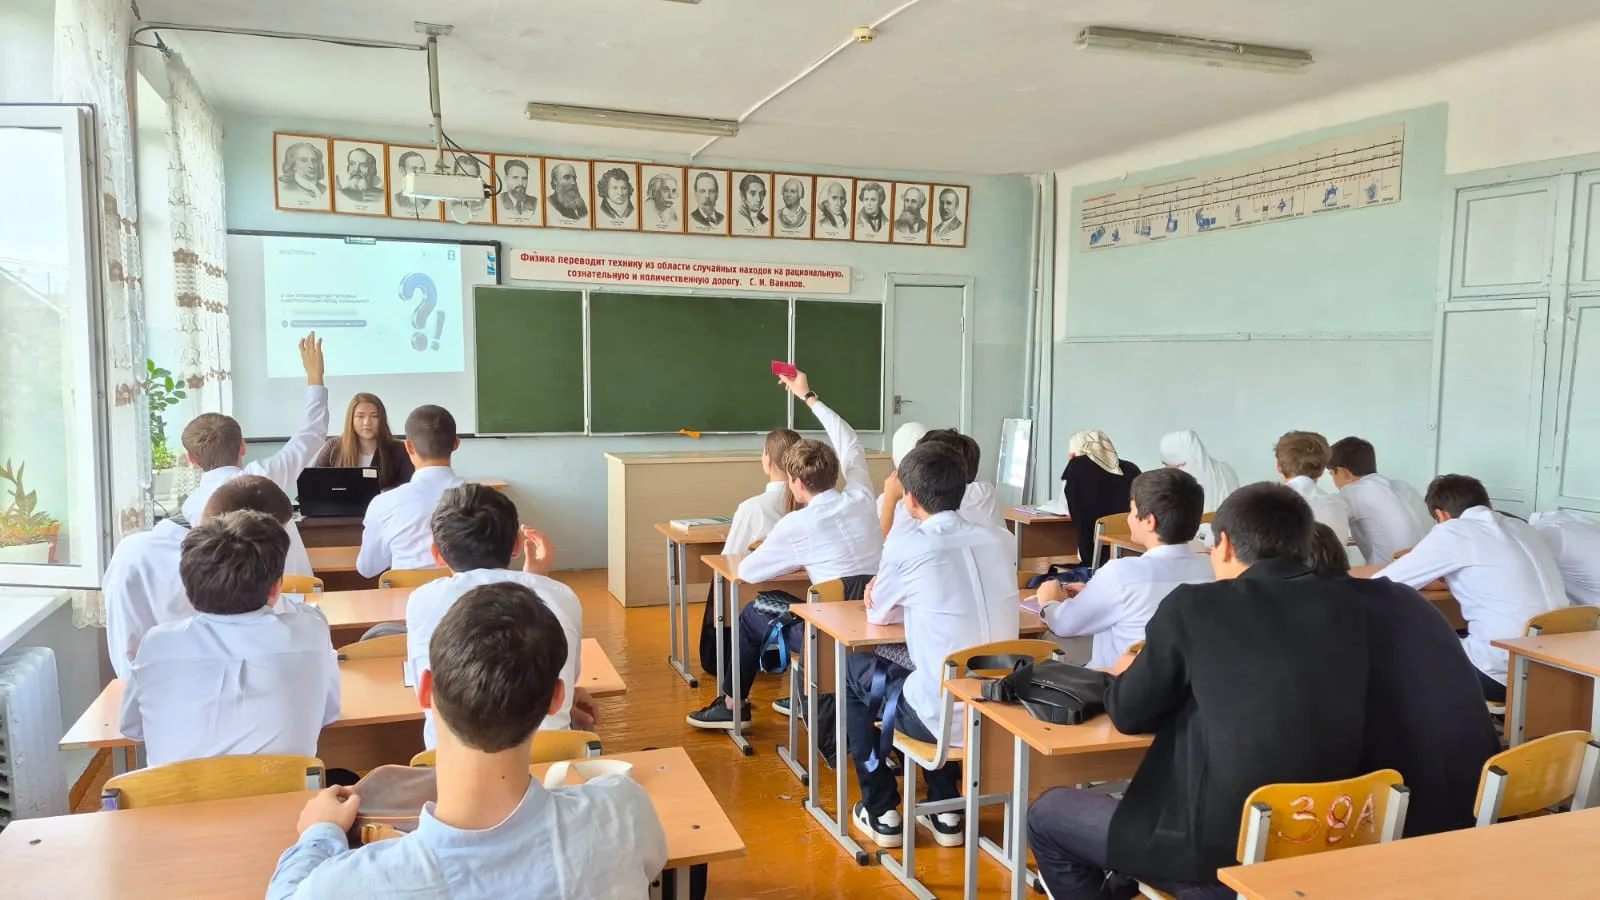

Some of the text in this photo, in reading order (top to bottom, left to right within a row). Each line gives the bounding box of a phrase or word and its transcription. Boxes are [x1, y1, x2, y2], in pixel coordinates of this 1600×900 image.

[520, 253, 555, 263] Физика
[558, 256, 605, 267] переводит
[608, 259, 643, 270] технику
[645, 261, 655, 269] из
[657, 261, 691, 271] области
[693, 264, 737, 274] случайных
[739, 267, 772, 276] находок
[567, 269, 630, 281] сознательную
[640, 274, 709, 286] количественную
[712, 277, 742, 287] дорогу.
[749, 278, 757, 286] С.
[769, 279, 805, 288] Вавилов.
